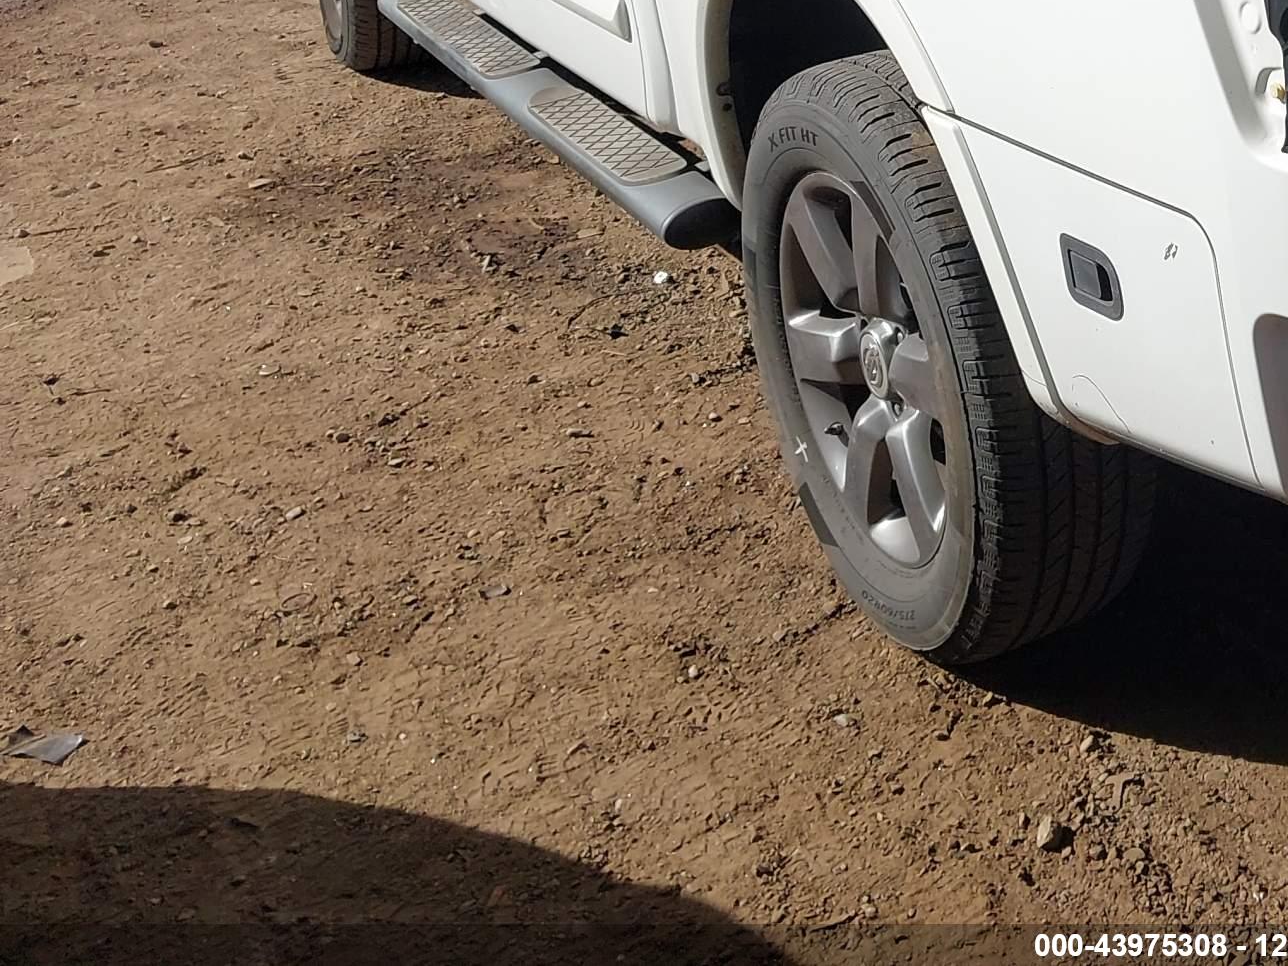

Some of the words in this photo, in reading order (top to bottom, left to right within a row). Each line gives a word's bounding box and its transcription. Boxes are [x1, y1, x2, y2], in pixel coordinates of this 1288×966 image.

[768, 132, 778, 153] X
[779, 126, 796, 144] FIT
[801, 127, 819, 146] HT
